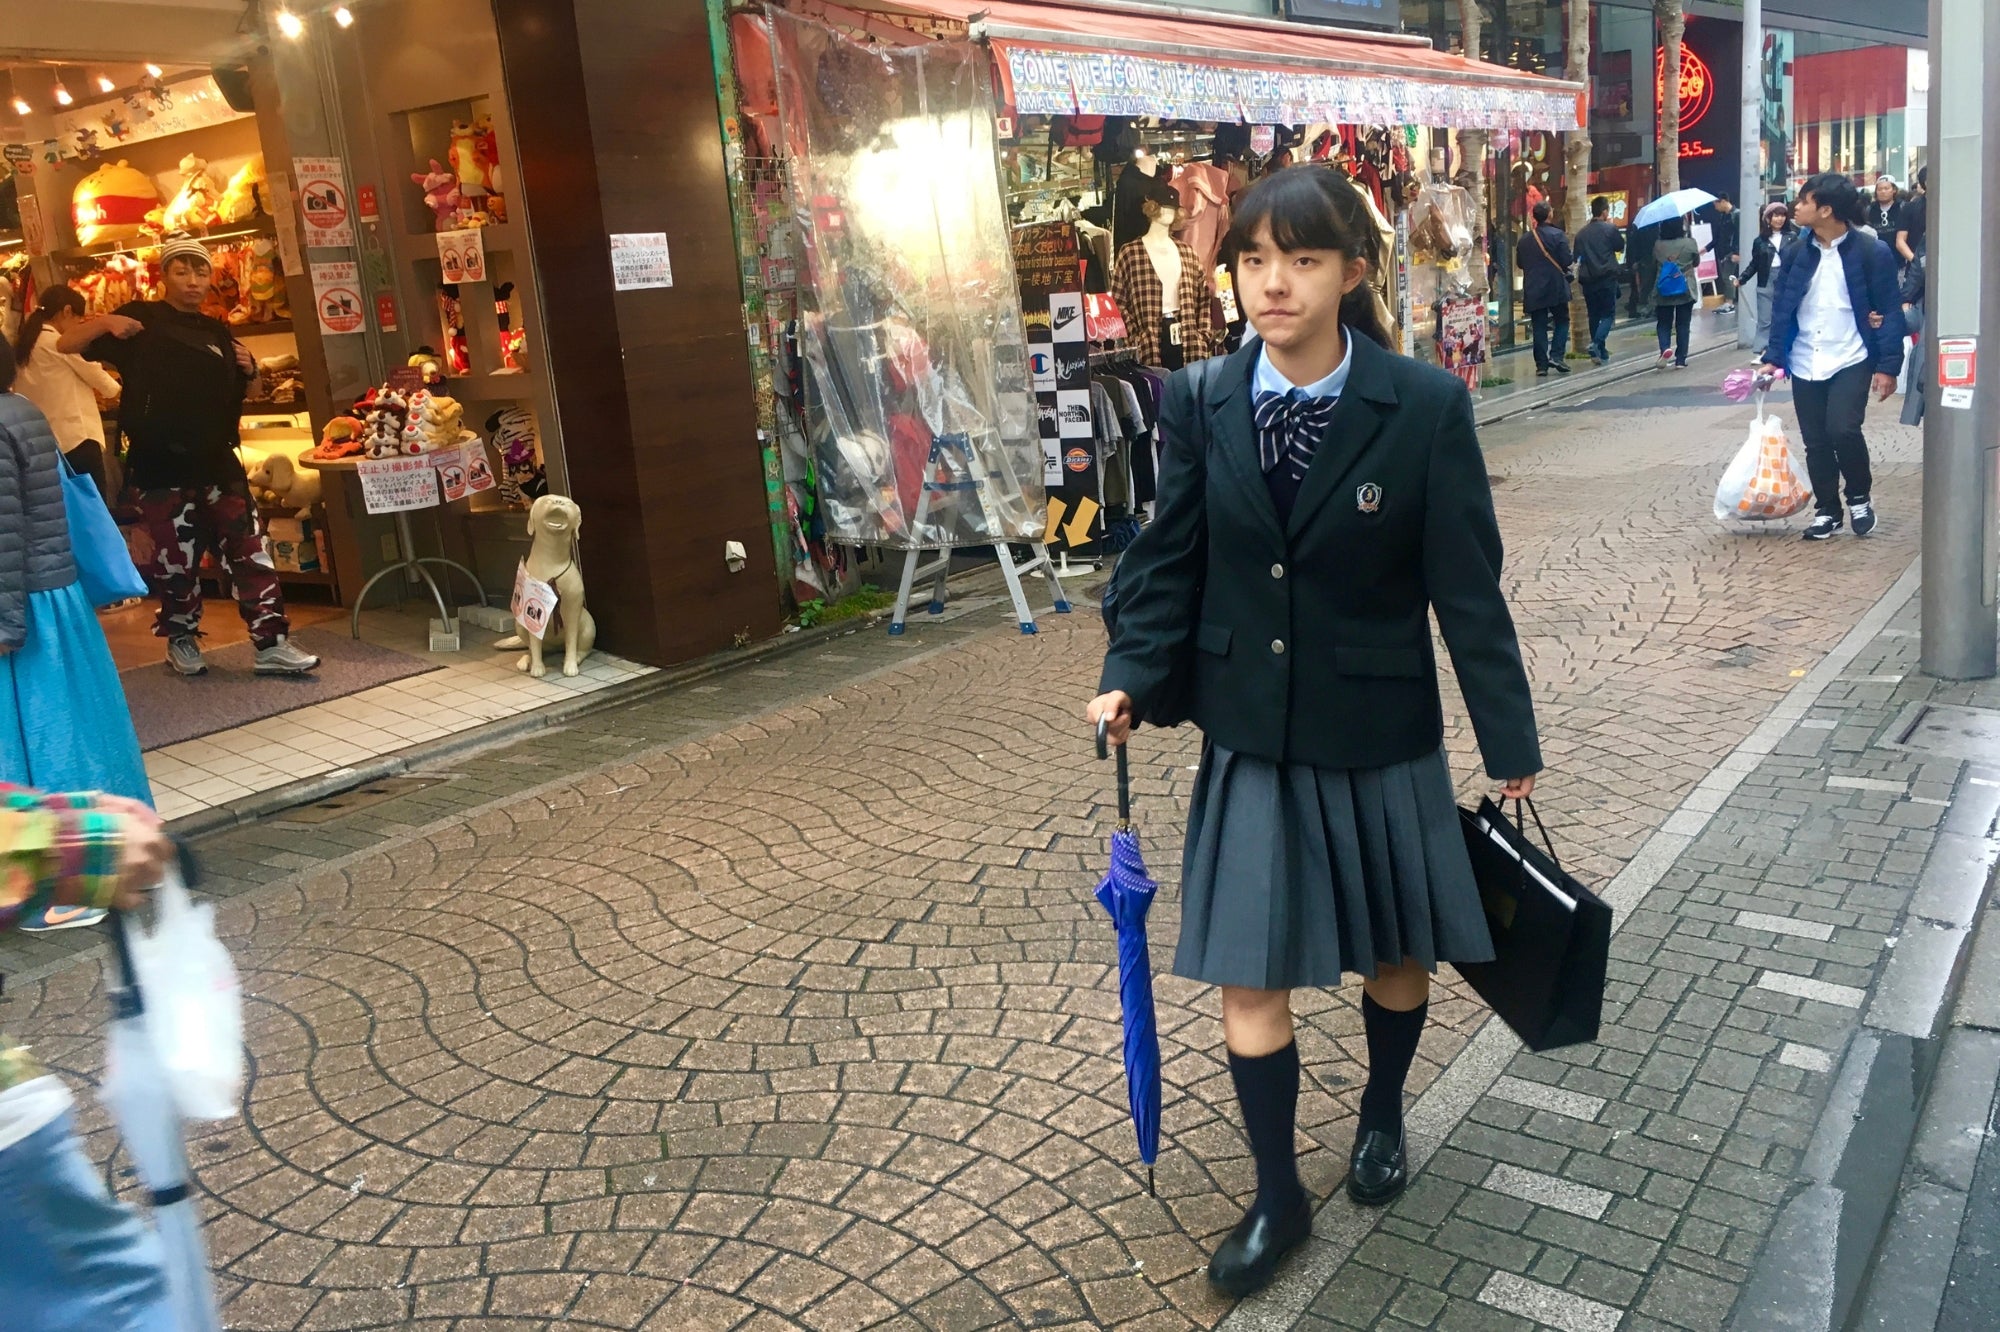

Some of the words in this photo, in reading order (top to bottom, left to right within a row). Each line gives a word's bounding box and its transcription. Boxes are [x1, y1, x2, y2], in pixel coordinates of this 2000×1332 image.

[1073, 58, 1159, 91] WELCOME
[1161, 69, 1237, 97] WELCOME
[1240, 74, 1308, 101] WELCOME
[1676, 141, 1713, 157] .3.5...
[1057, 306, 1075, 320] NIKE
